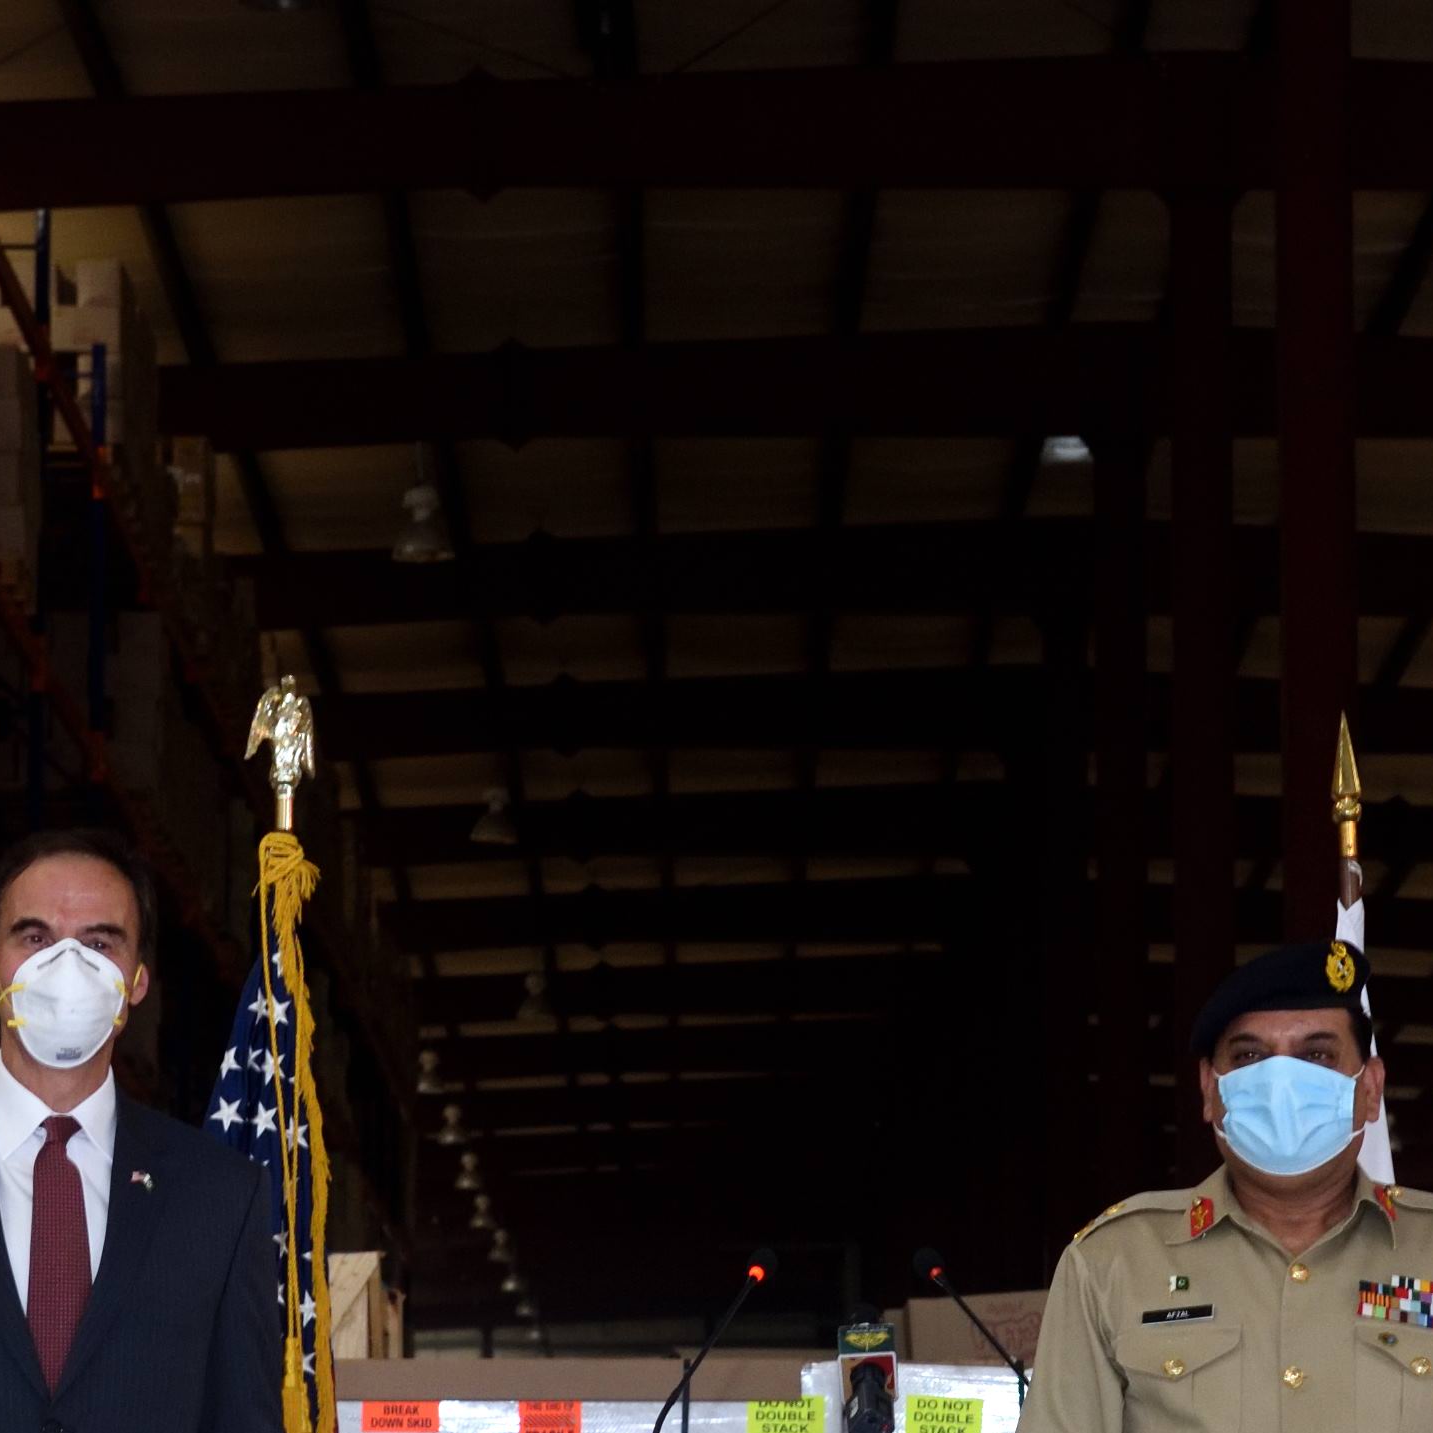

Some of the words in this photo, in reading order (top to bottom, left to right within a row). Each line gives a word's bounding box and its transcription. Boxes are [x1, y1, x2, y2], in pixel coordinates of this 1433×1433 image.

[1166, 1309, 1190, 1320] AFZAL
[758, 1400, 780, 1408] DO
[784, 1398, 813, 1409] NOT
[916, 1398, 938, 1410] DO
[942, 1400, 972, 1412] NOT
[383, 1405, 420, 1415] BREAK
[755, 1410, 816, 1421] DOUBLE
[370, 1418, 403, 1428] DOWN
[407, 1418, 432, 1428] SKID
[913, 1412, 975, 1424] DOUBLE
